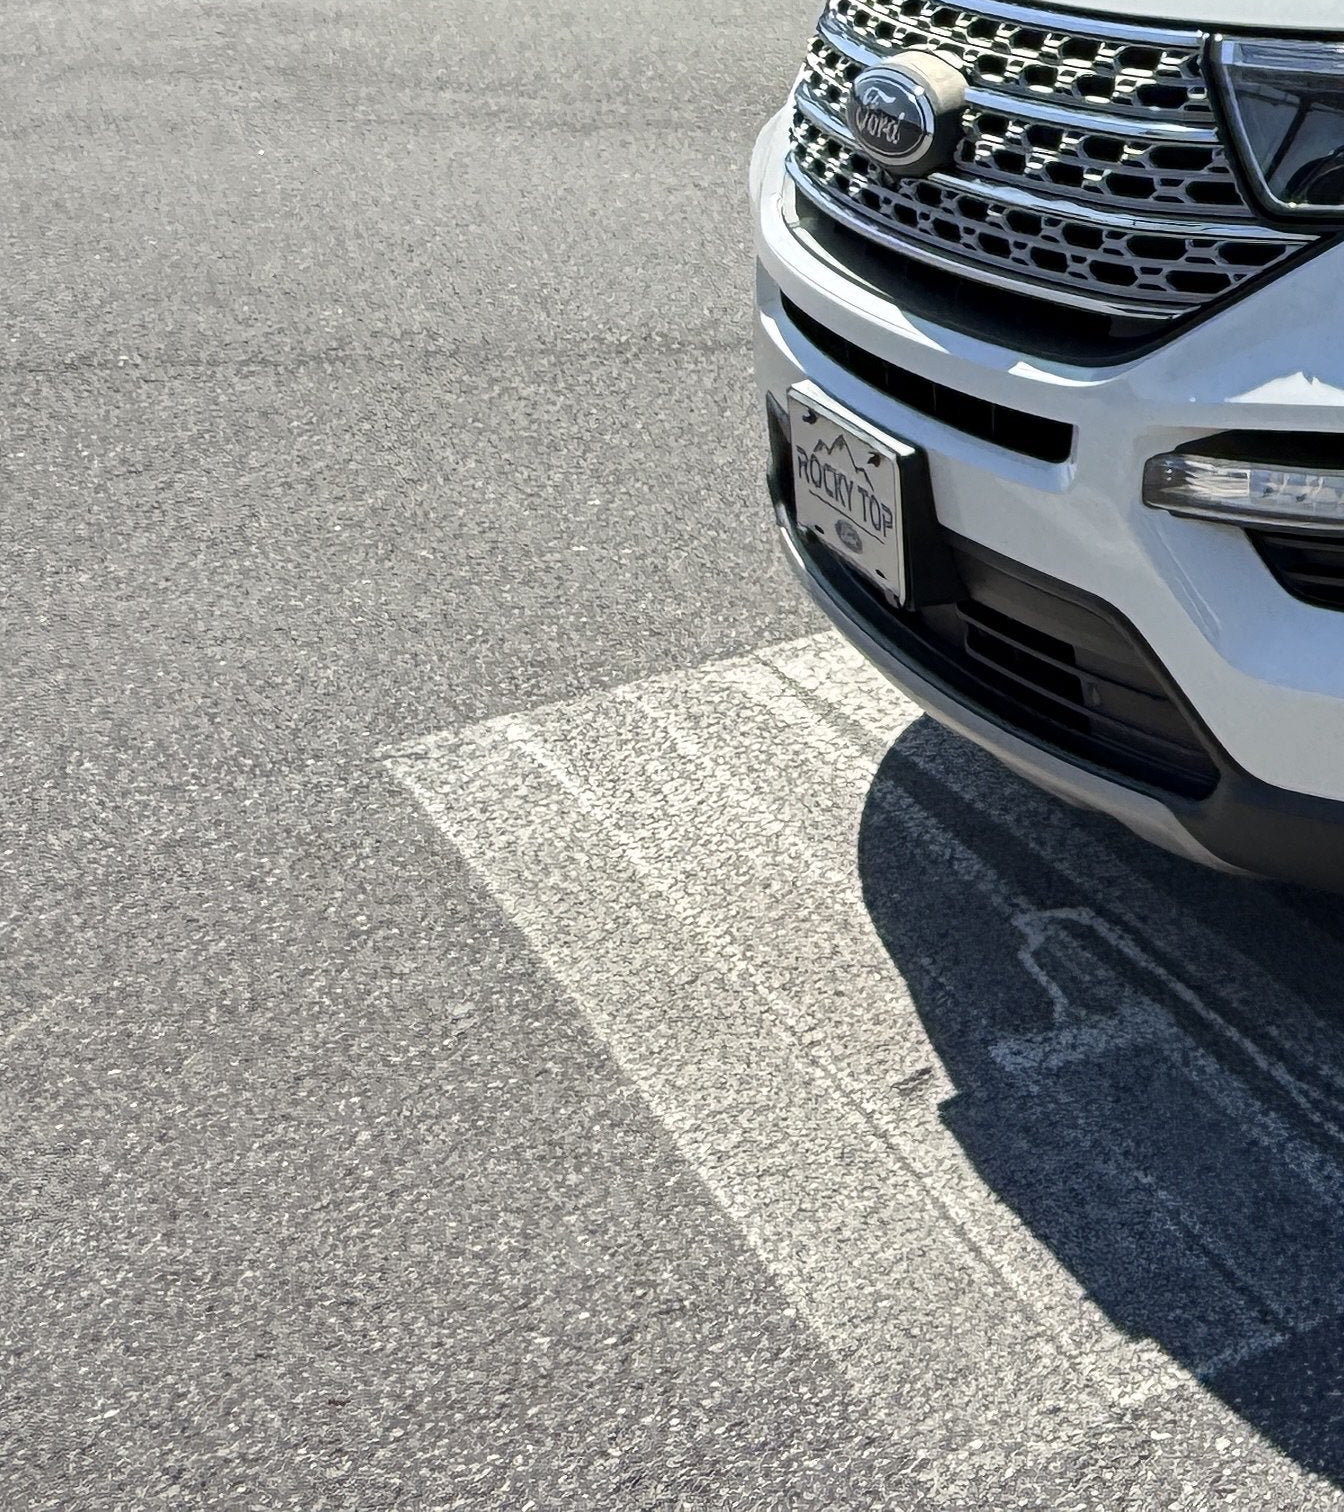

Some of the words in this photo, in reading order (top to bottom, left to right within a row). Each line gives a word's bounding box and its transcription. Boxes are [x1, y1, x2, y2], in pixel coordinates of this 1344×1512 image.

[856, 86, 905, 145] Ford
[796, 444, 854, 511] ROCKY
[857, 485, 894, 538] TOP
